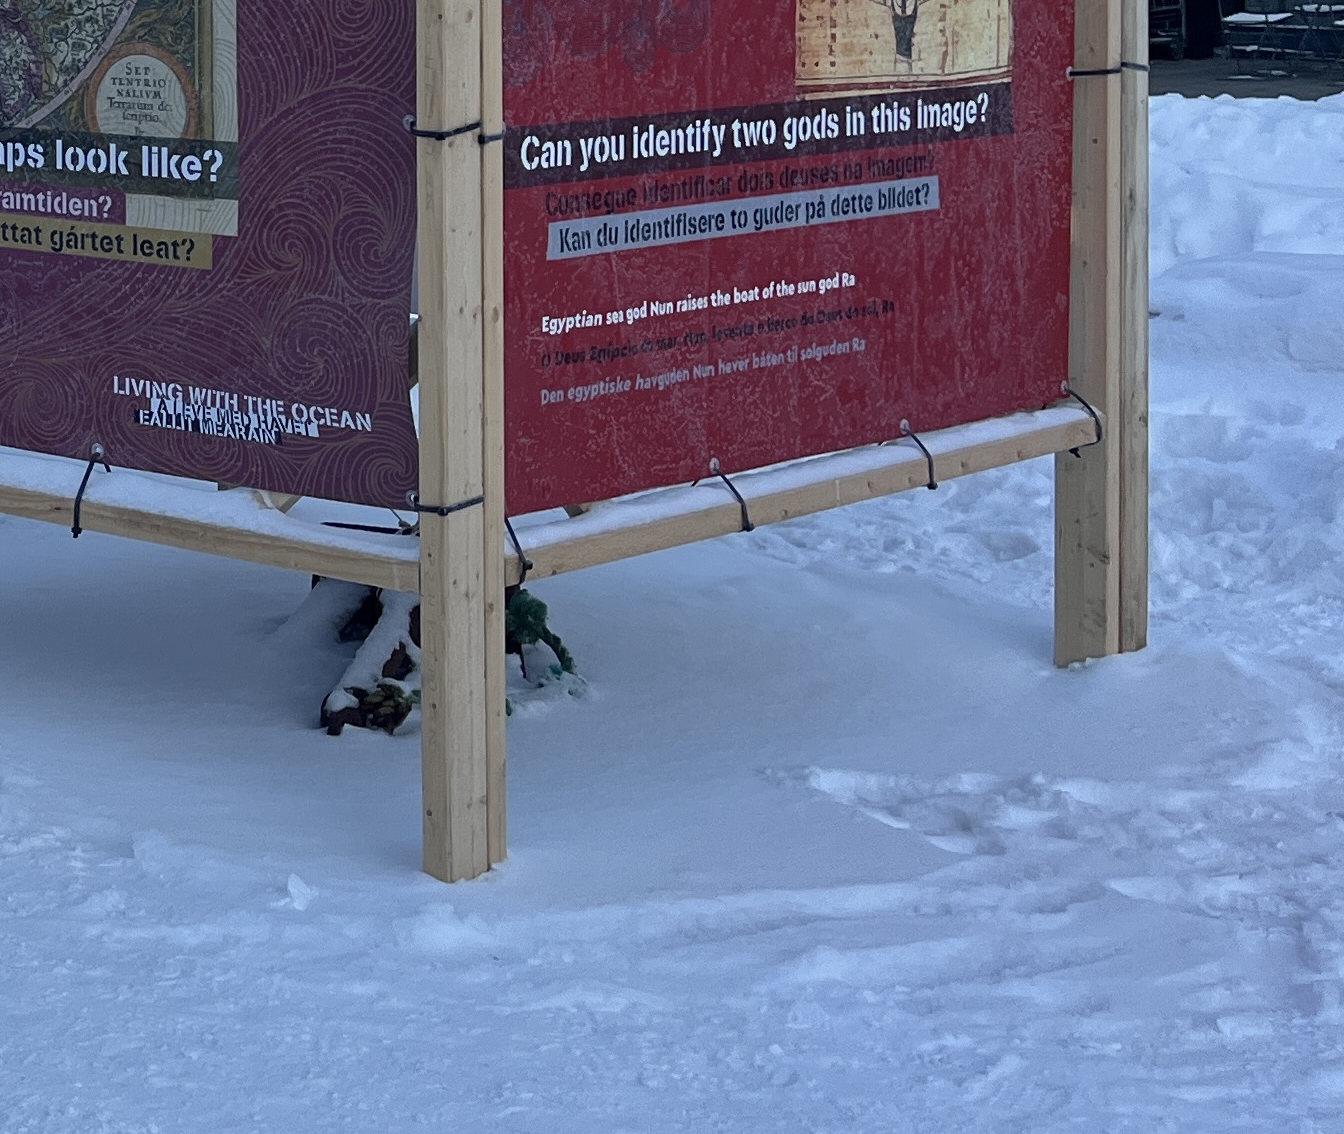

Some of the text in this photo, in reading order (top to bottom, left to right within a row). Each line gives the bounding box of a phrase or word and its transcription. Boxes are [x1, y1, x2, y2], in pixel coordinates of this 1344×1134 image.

[110, 77, 166, 88] TENTRIO
[55, 139, 130, 176] look
[142, 145, 224, 182] like?
[520, 92, 990, 172] Can you identify two gods in this image?
[546, 150, 936, 215] Consegue identificar dois deuses na imagem?
[50, 226, 124, 254] gártet
[132, 233, 195, 261] leat?
[560, 182, 930, 253] Kan du identifisere to guder på dette bildet?
[541, 271, 856, 335] Egyptian sea god Nun raises the boat of the sun god Ra
[113, 375, 373, 432] LIVING WITH THE OCEAN
[541, 337, 866, 406] Den egyptiske havguden Nun hever båten til solguden Ra
